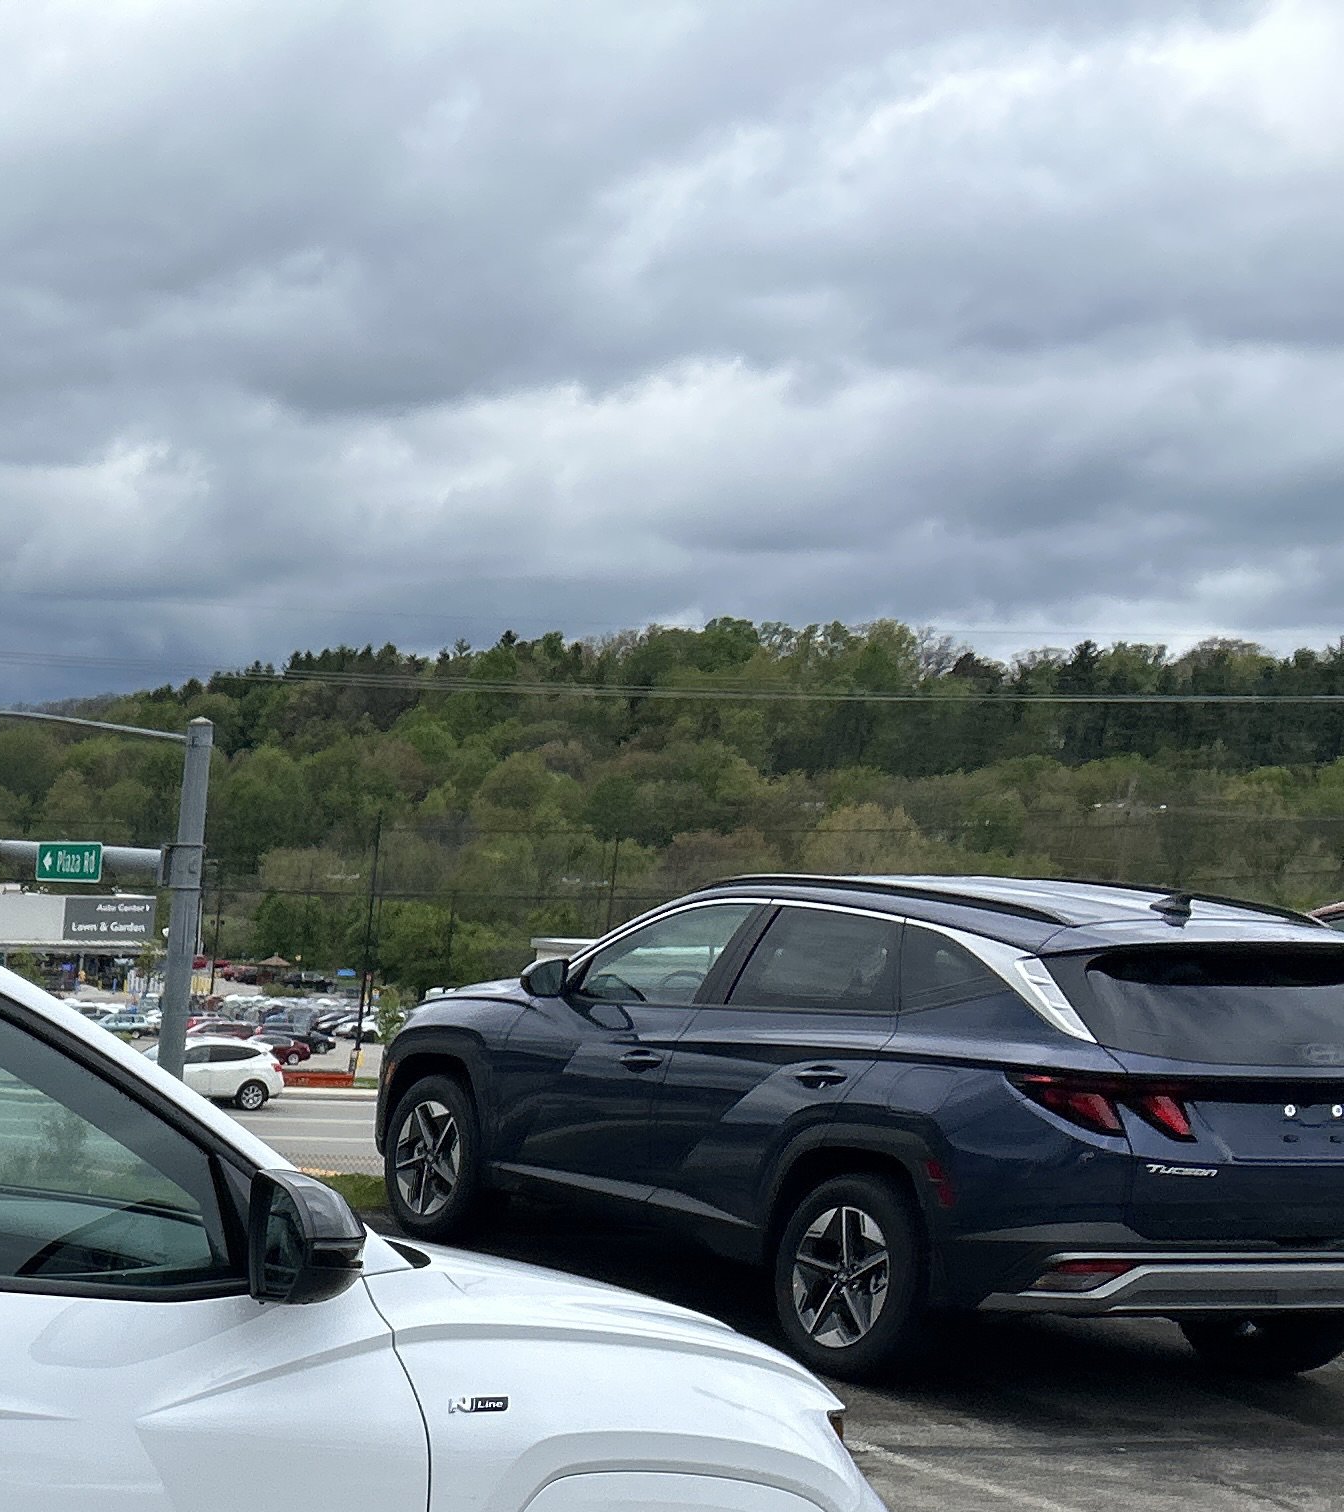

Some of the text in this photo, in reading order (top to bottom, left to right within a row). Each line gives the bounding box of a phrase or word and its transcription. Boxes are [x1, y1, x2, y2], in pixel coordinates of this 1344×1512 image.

[56, 849, 96, 874] Plaza Rd
[72, 921, 146, 932] Lawn & Garden
